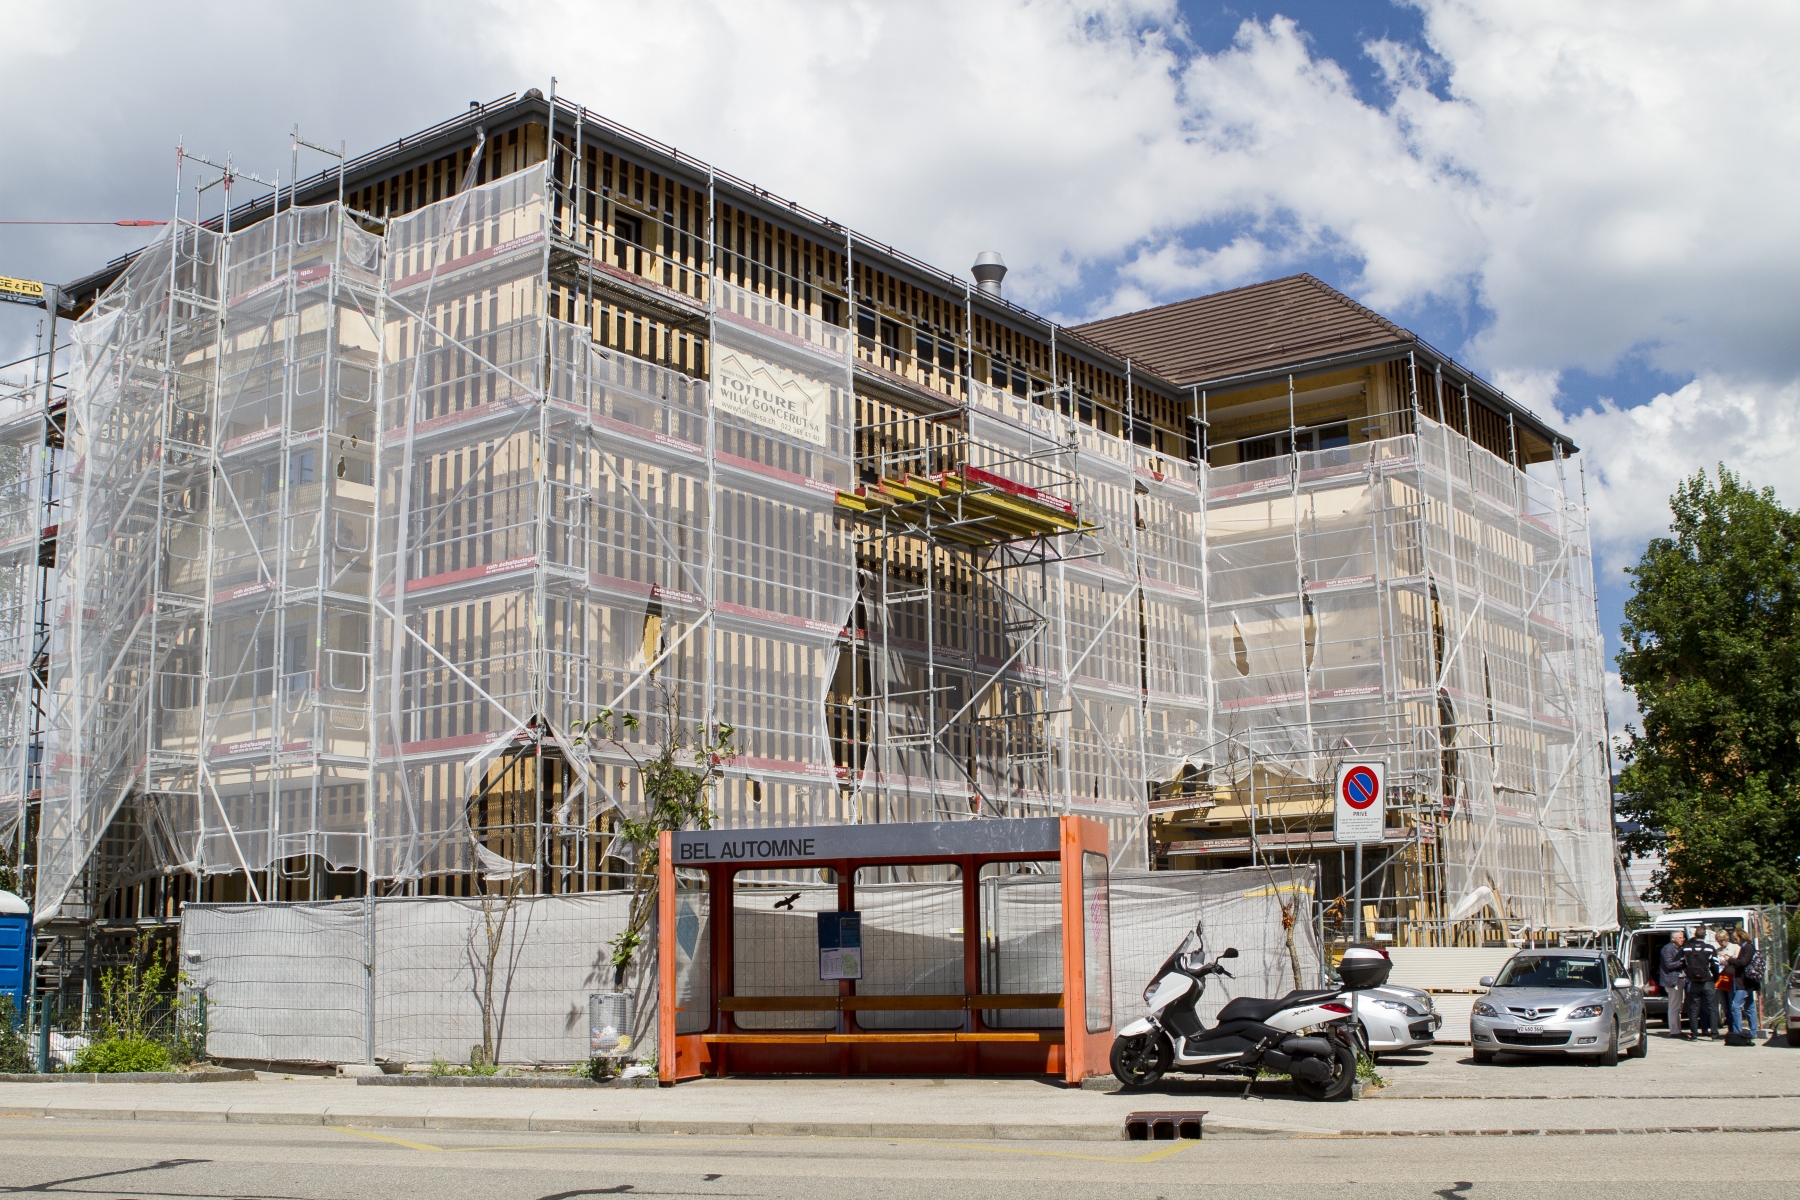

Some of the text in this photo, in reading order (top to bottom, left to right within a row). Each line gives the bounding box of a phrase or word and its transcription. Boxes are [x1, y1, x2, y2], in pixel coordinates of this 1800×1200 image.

[720, 374, 797, 413] TOITURE
[720, 388, 819, 433] WILLY GONCERUT SA
[721, 401, 776, 426] www.toiture-sa.ch
[781, 422, 791, 432] 022
[680, 838, 816, 860] BEL AUTOMNE
